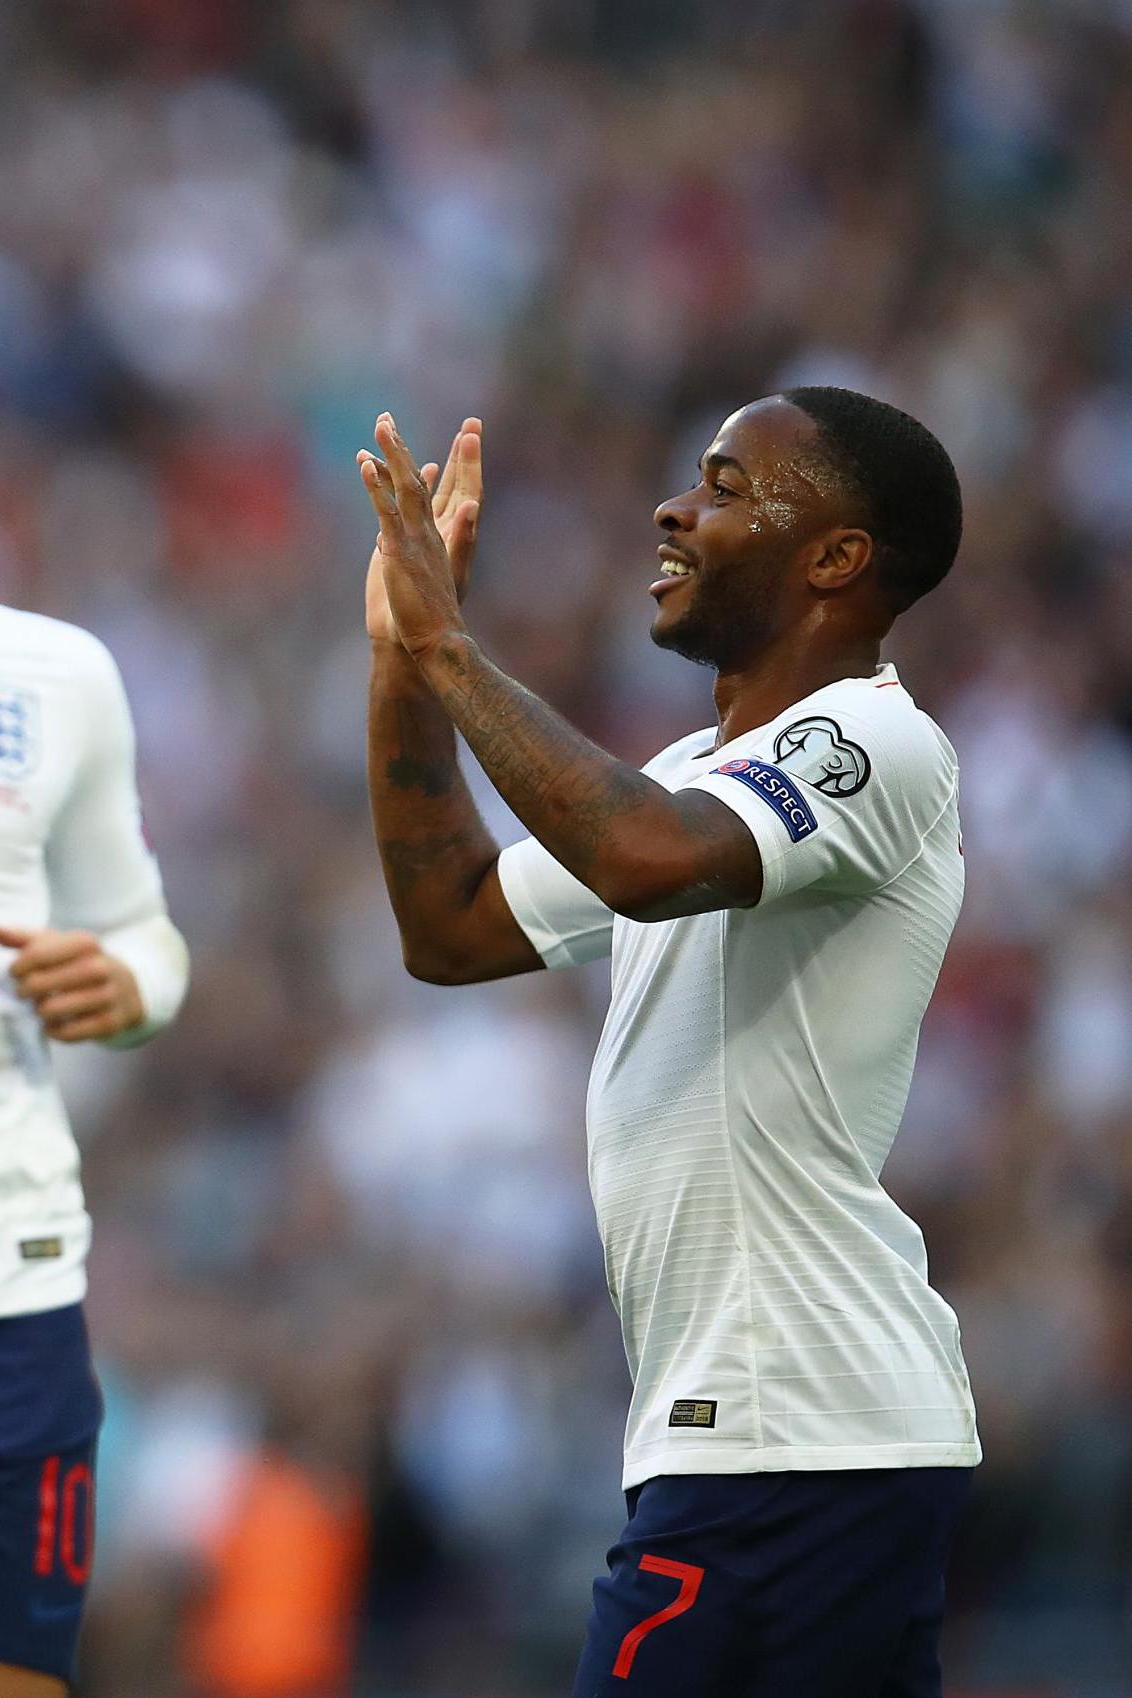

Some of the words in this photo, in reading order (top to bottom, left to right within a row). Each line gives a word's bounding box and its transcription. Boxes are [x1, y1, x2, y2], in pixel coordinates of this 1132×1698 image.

[745, 766, 811, 833] RESPECT
[34, 1455, 94, 1587] 10
[612, 1553, 705, 1679] 7
